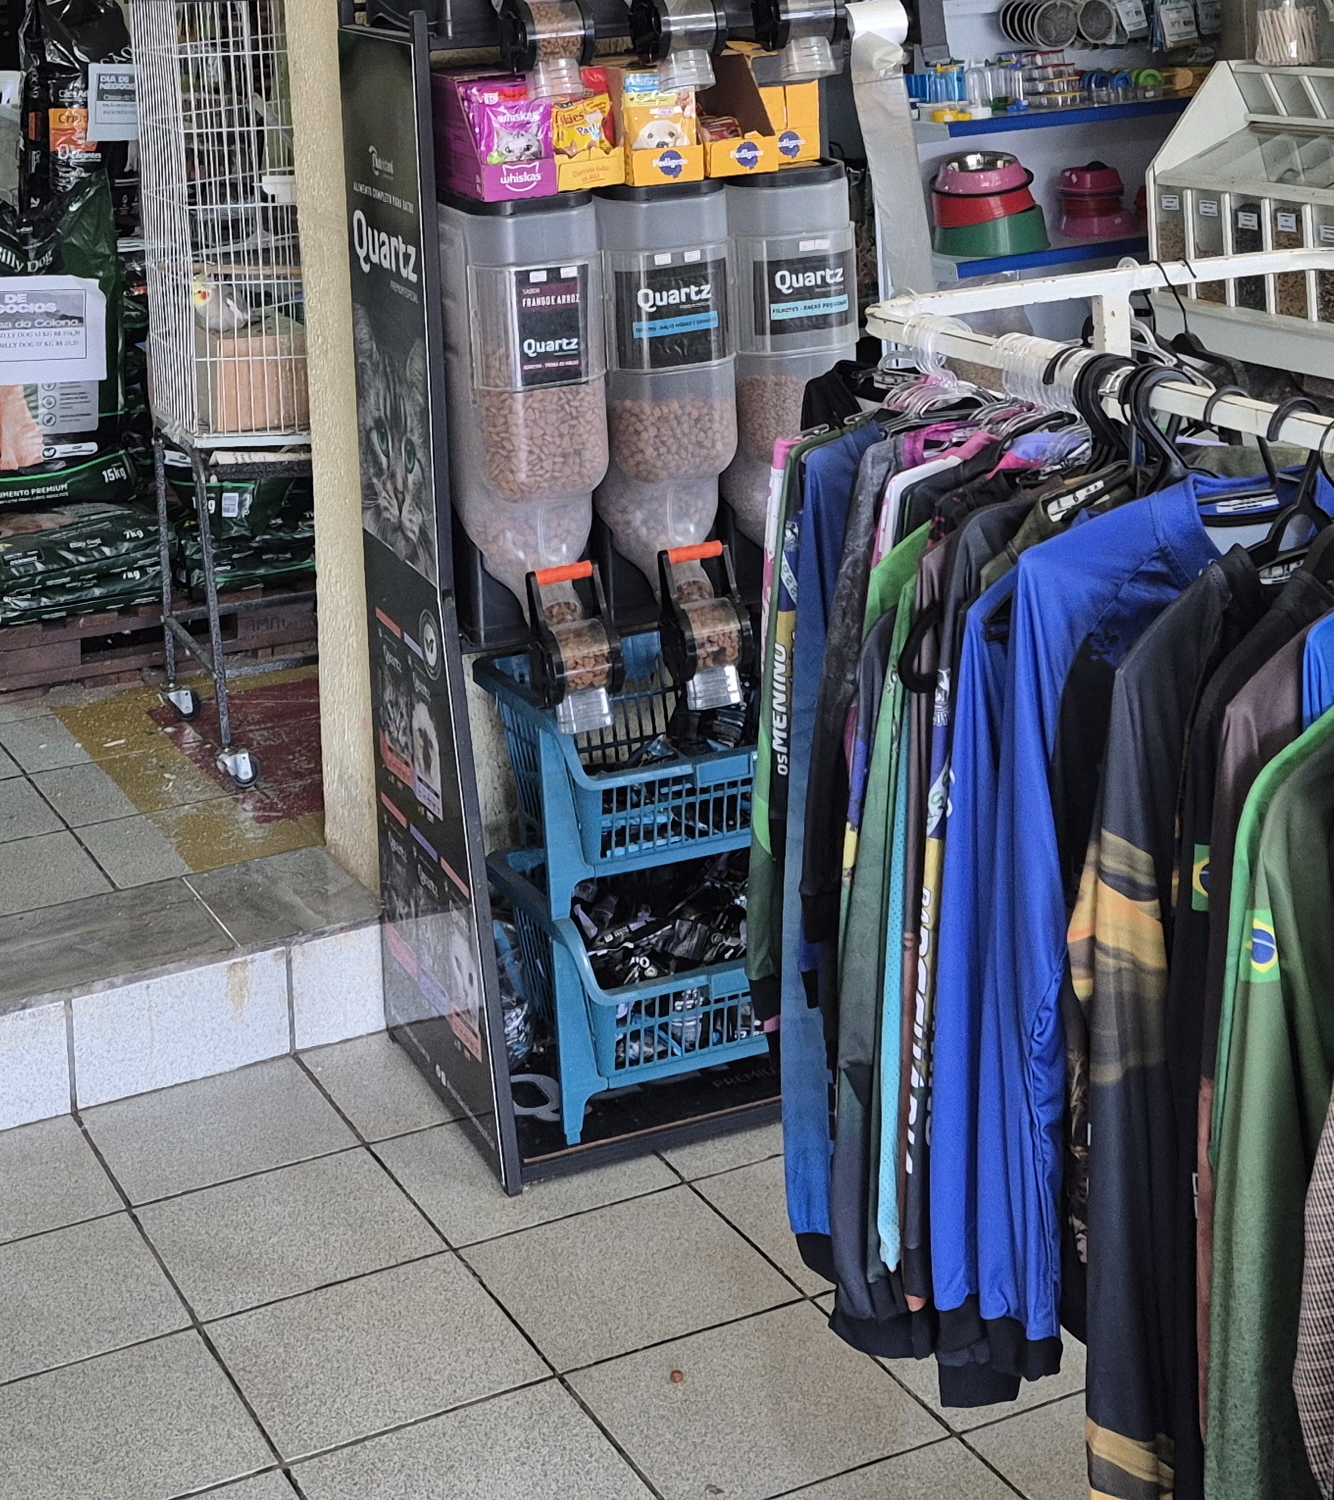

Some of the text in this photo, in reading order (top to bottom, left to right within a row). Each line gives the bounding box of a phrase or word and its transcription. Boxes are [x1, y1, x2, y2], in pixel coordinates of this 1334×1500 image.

[99, 75, 116, 83] DIA
[500, 171, 542, 185] whiskas
[352, 209, 418, 284] Quartz
[26, 249, 53, 273] Dog
[774, 267, 845, 295] Quartz
[4, 293, 28, 304] DE
[522, 295, 551, 308] FRANGO
[637, 283, 712, 313] Quartz
[15, 319, 32, 329] do
[34, 318, 79, 328] Colono
[523, 337, 579, 358] Quartz
[101, 465, 128, 484] 15kg
[30, 483, 68, 496] PREMIUM
[777, 753, 789, 777] OS
